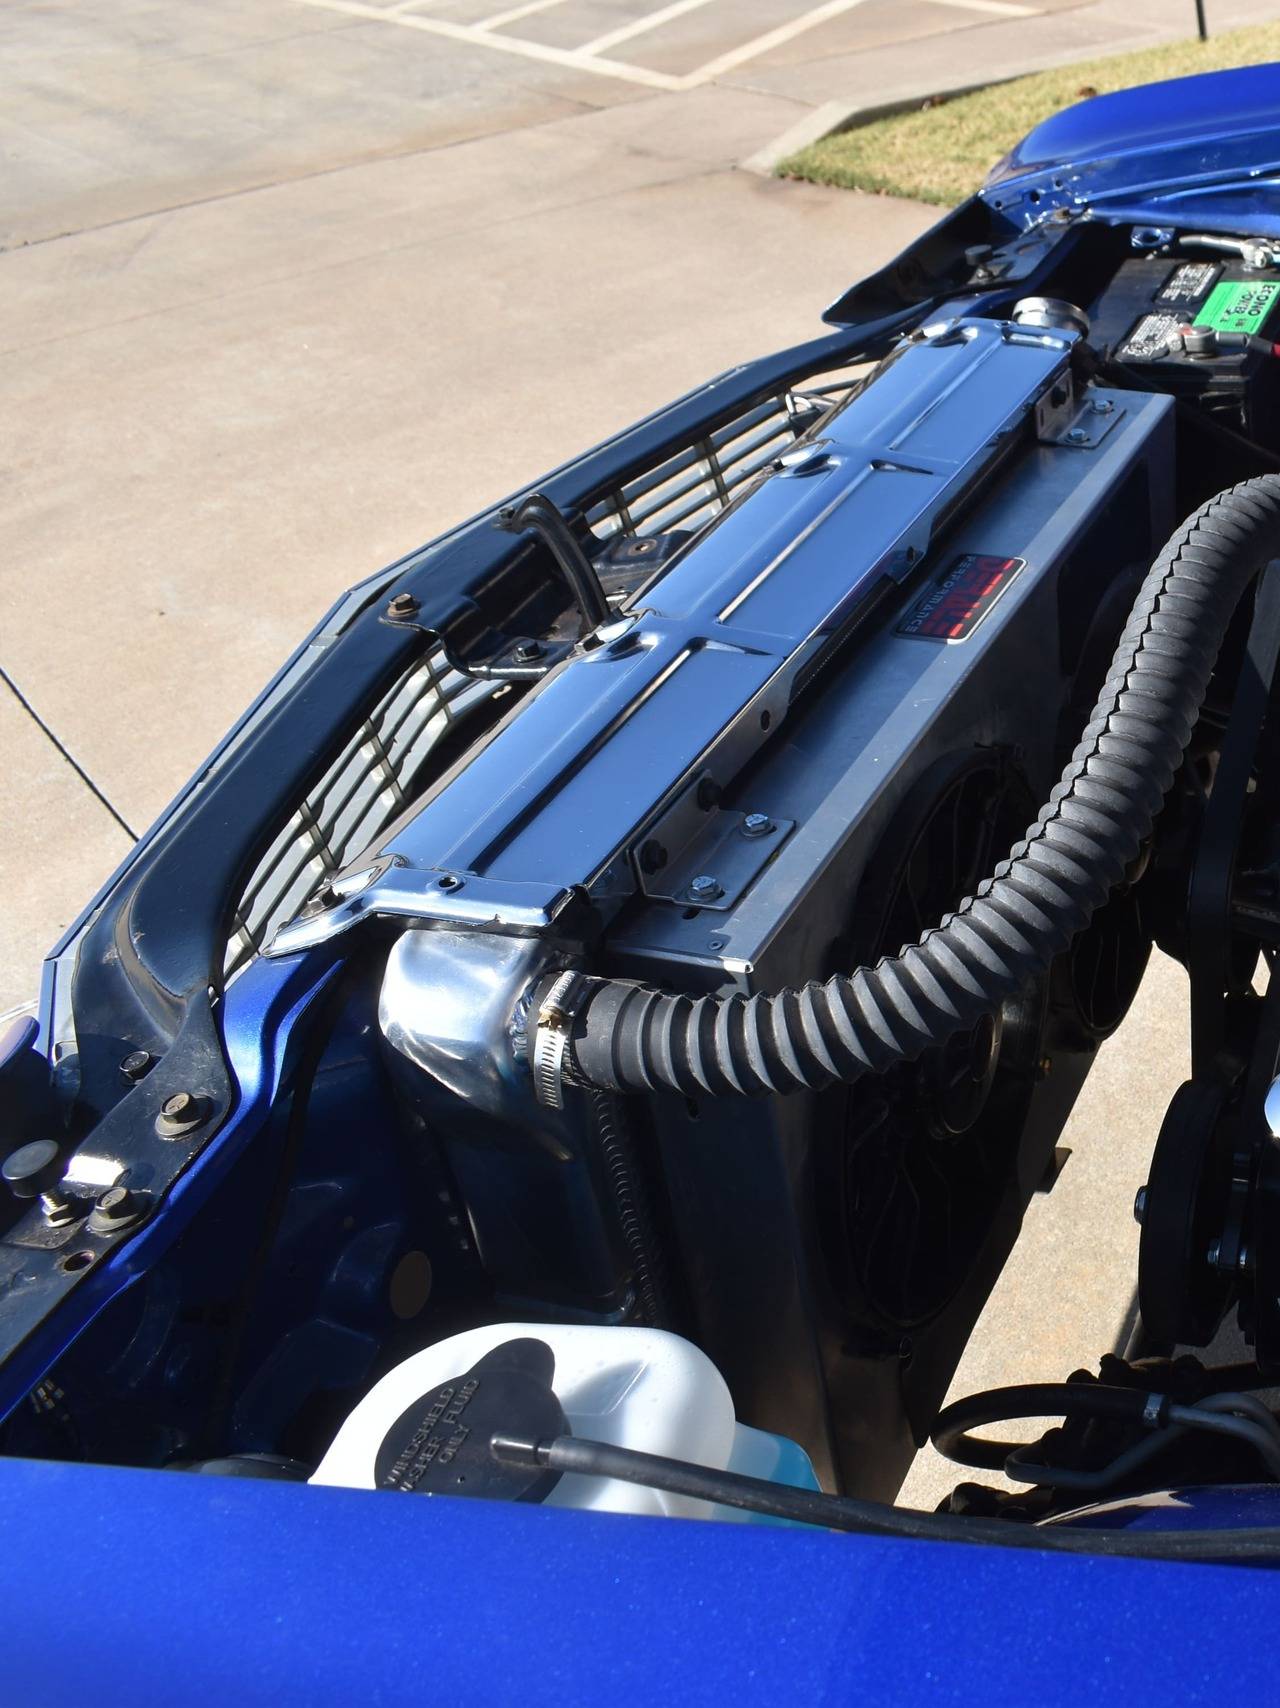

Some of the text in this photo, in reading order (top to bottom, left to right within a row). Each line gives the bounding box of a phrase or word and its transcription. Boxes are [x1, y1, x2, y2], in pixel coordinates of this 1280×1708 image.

[443, 1378, 480, 1425] FLUID
[384, 1387, 455, 1485] WINDSHIELD
[438, 1423, 472, 1464] ONLY
